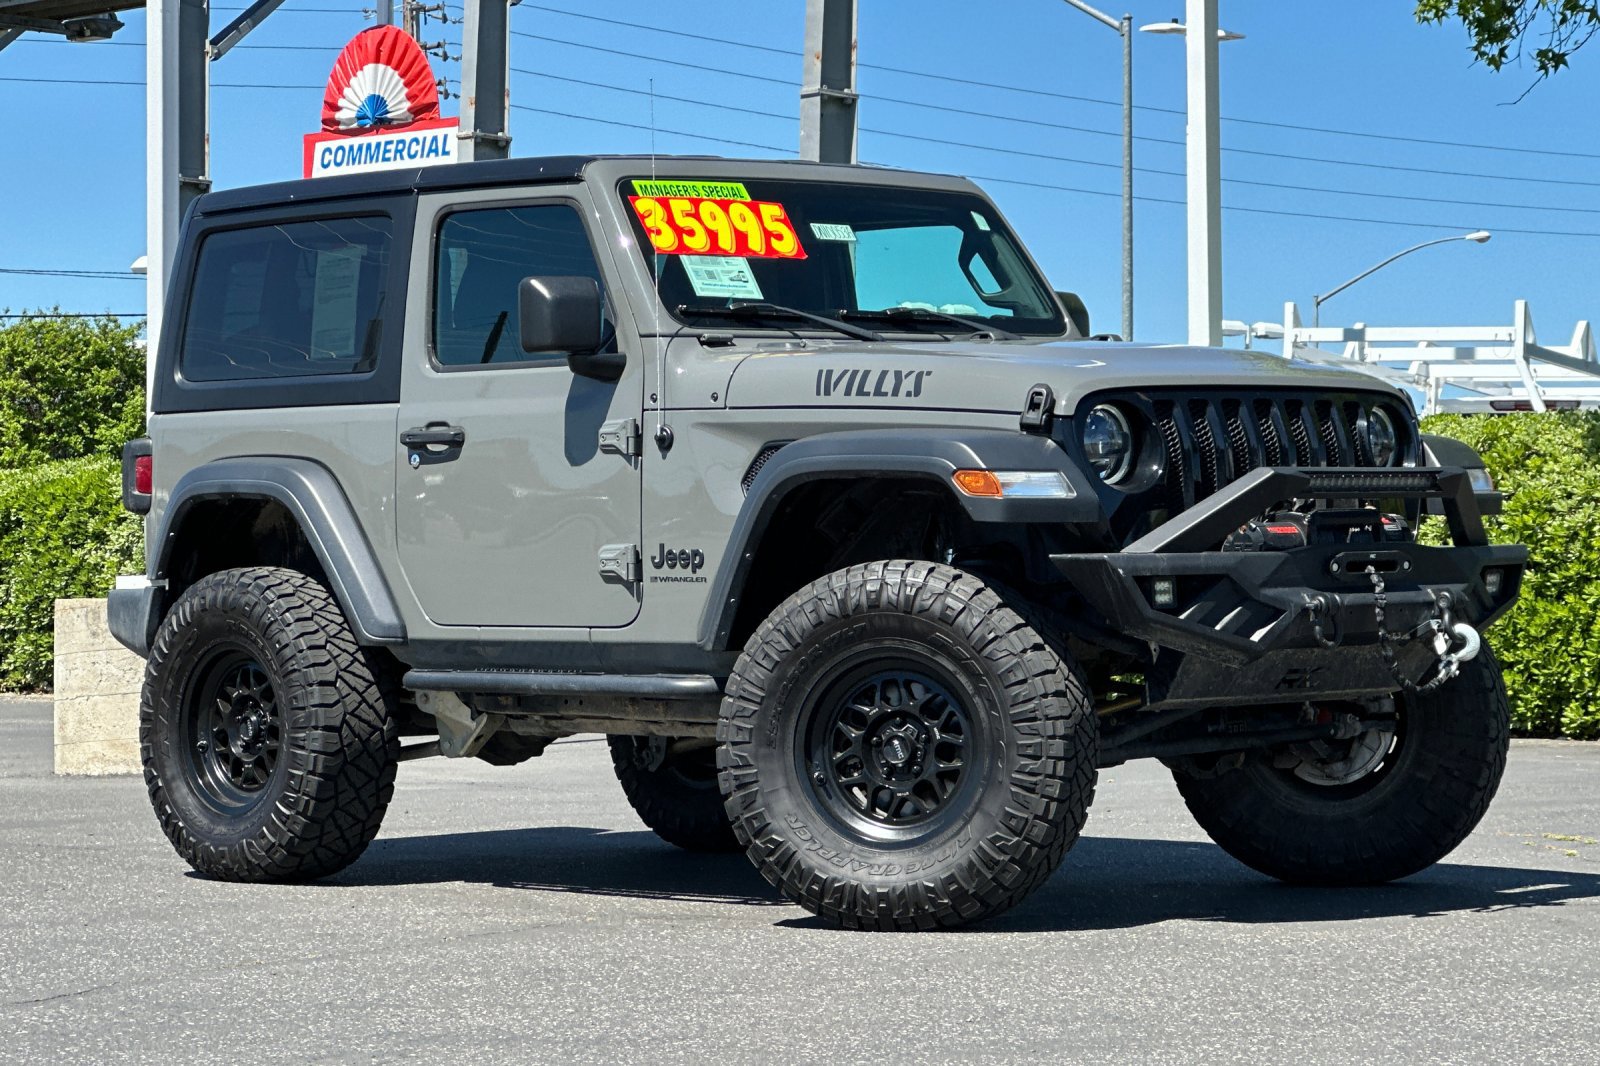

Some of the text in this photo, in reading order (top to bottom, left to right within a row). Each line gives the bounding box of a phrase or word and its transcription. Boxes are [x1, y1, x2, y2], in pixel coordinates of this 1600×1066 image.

[321, 134, 451, 169] COMMERCIAL
[639, 184, 744, 199] MANAGER'S SPECIAL
[634, 197, 799, 256] 35995
[816, 369, 933, 397] WILLYS
[651, 543, 704, 574] Jeep
